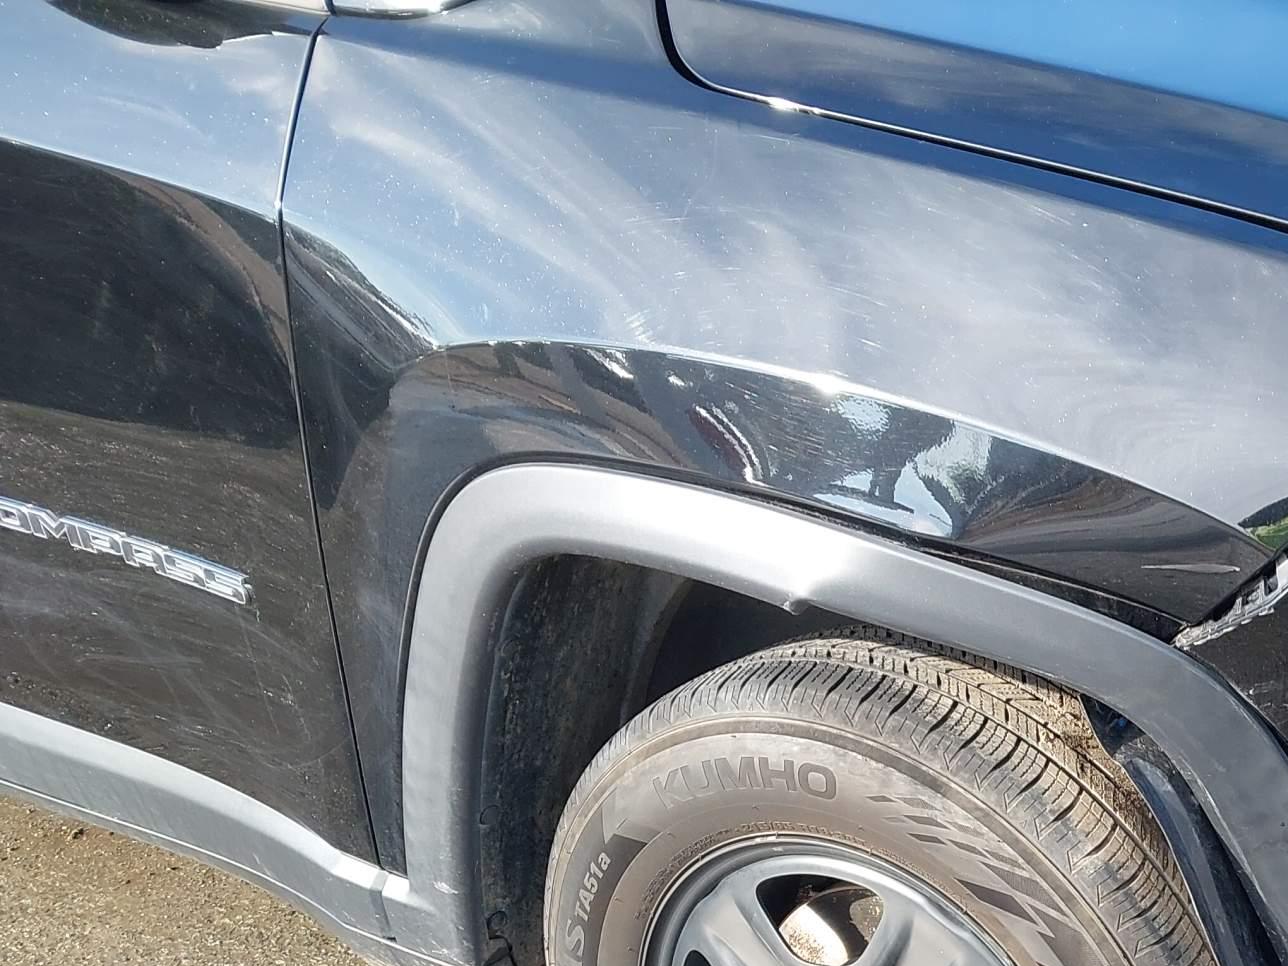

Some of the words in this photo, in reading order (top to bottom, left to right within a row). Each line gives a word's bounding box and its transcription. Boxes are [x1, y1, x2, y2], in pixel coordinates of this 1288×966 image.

[0, 496, 252, 604] OMPASS
[652, 756, 837, 809] KUMHO
[575, 852, 612, 922] TA51a
